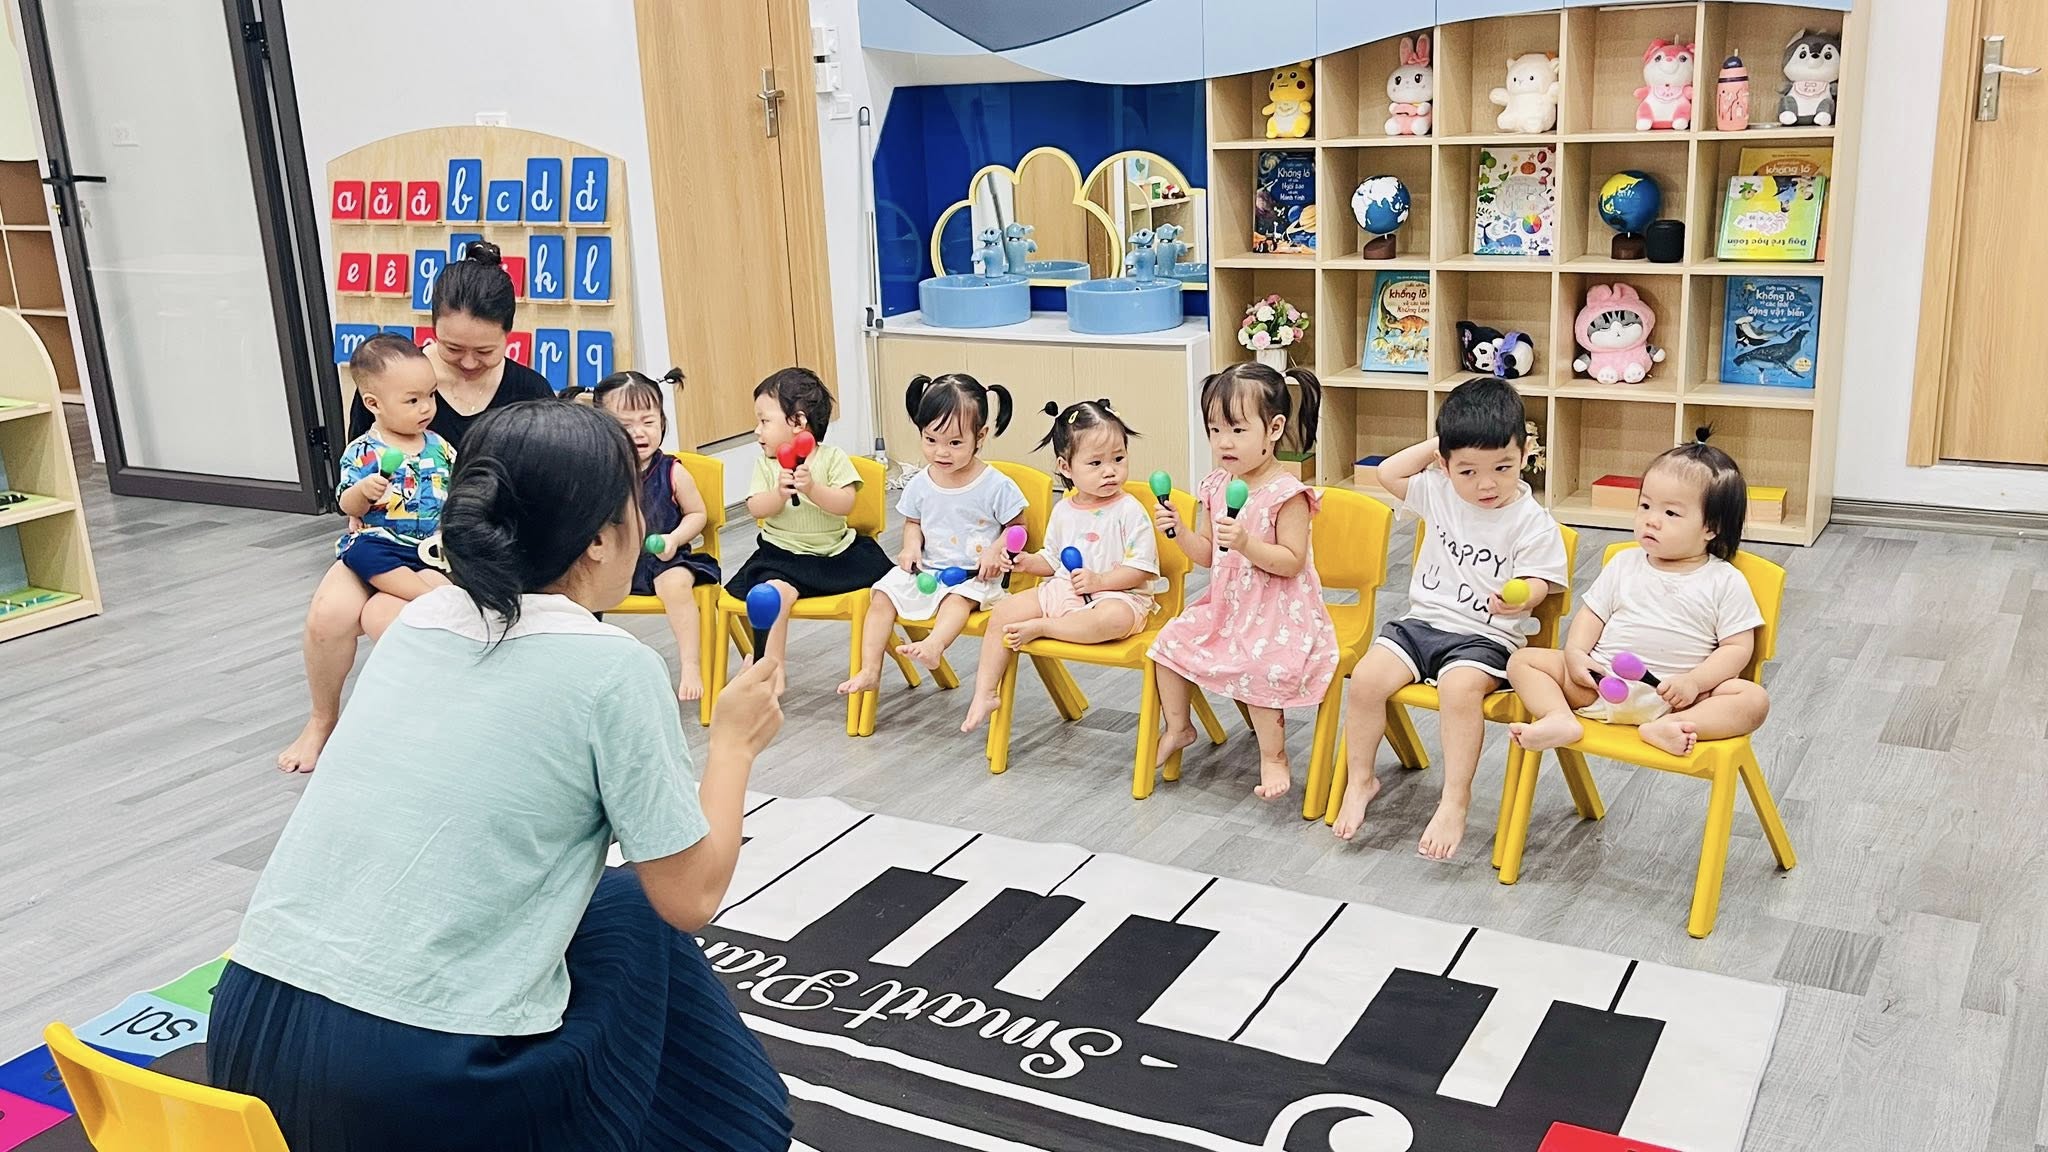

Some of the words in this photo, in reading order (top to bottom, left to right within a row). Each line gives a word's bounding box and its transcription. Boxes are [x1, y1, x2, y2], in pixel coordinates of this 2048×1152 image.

[337, 191, 357, 212] a
[373, 187, 393, 215] ă
[411, 188, 431, 216] â
[452, 167, 473, 215] b
[496, 191, 510, 212] c
[531, 171, 553, 212] d
[575, 171, 599, 212] đ
[347, 262, 360, 283] e
[384, 260, 397, 286] ê
[583, 244, 600, 295] l
[586, 344, 603, 385] q
[833, 980, 1123, 1079] Smart
